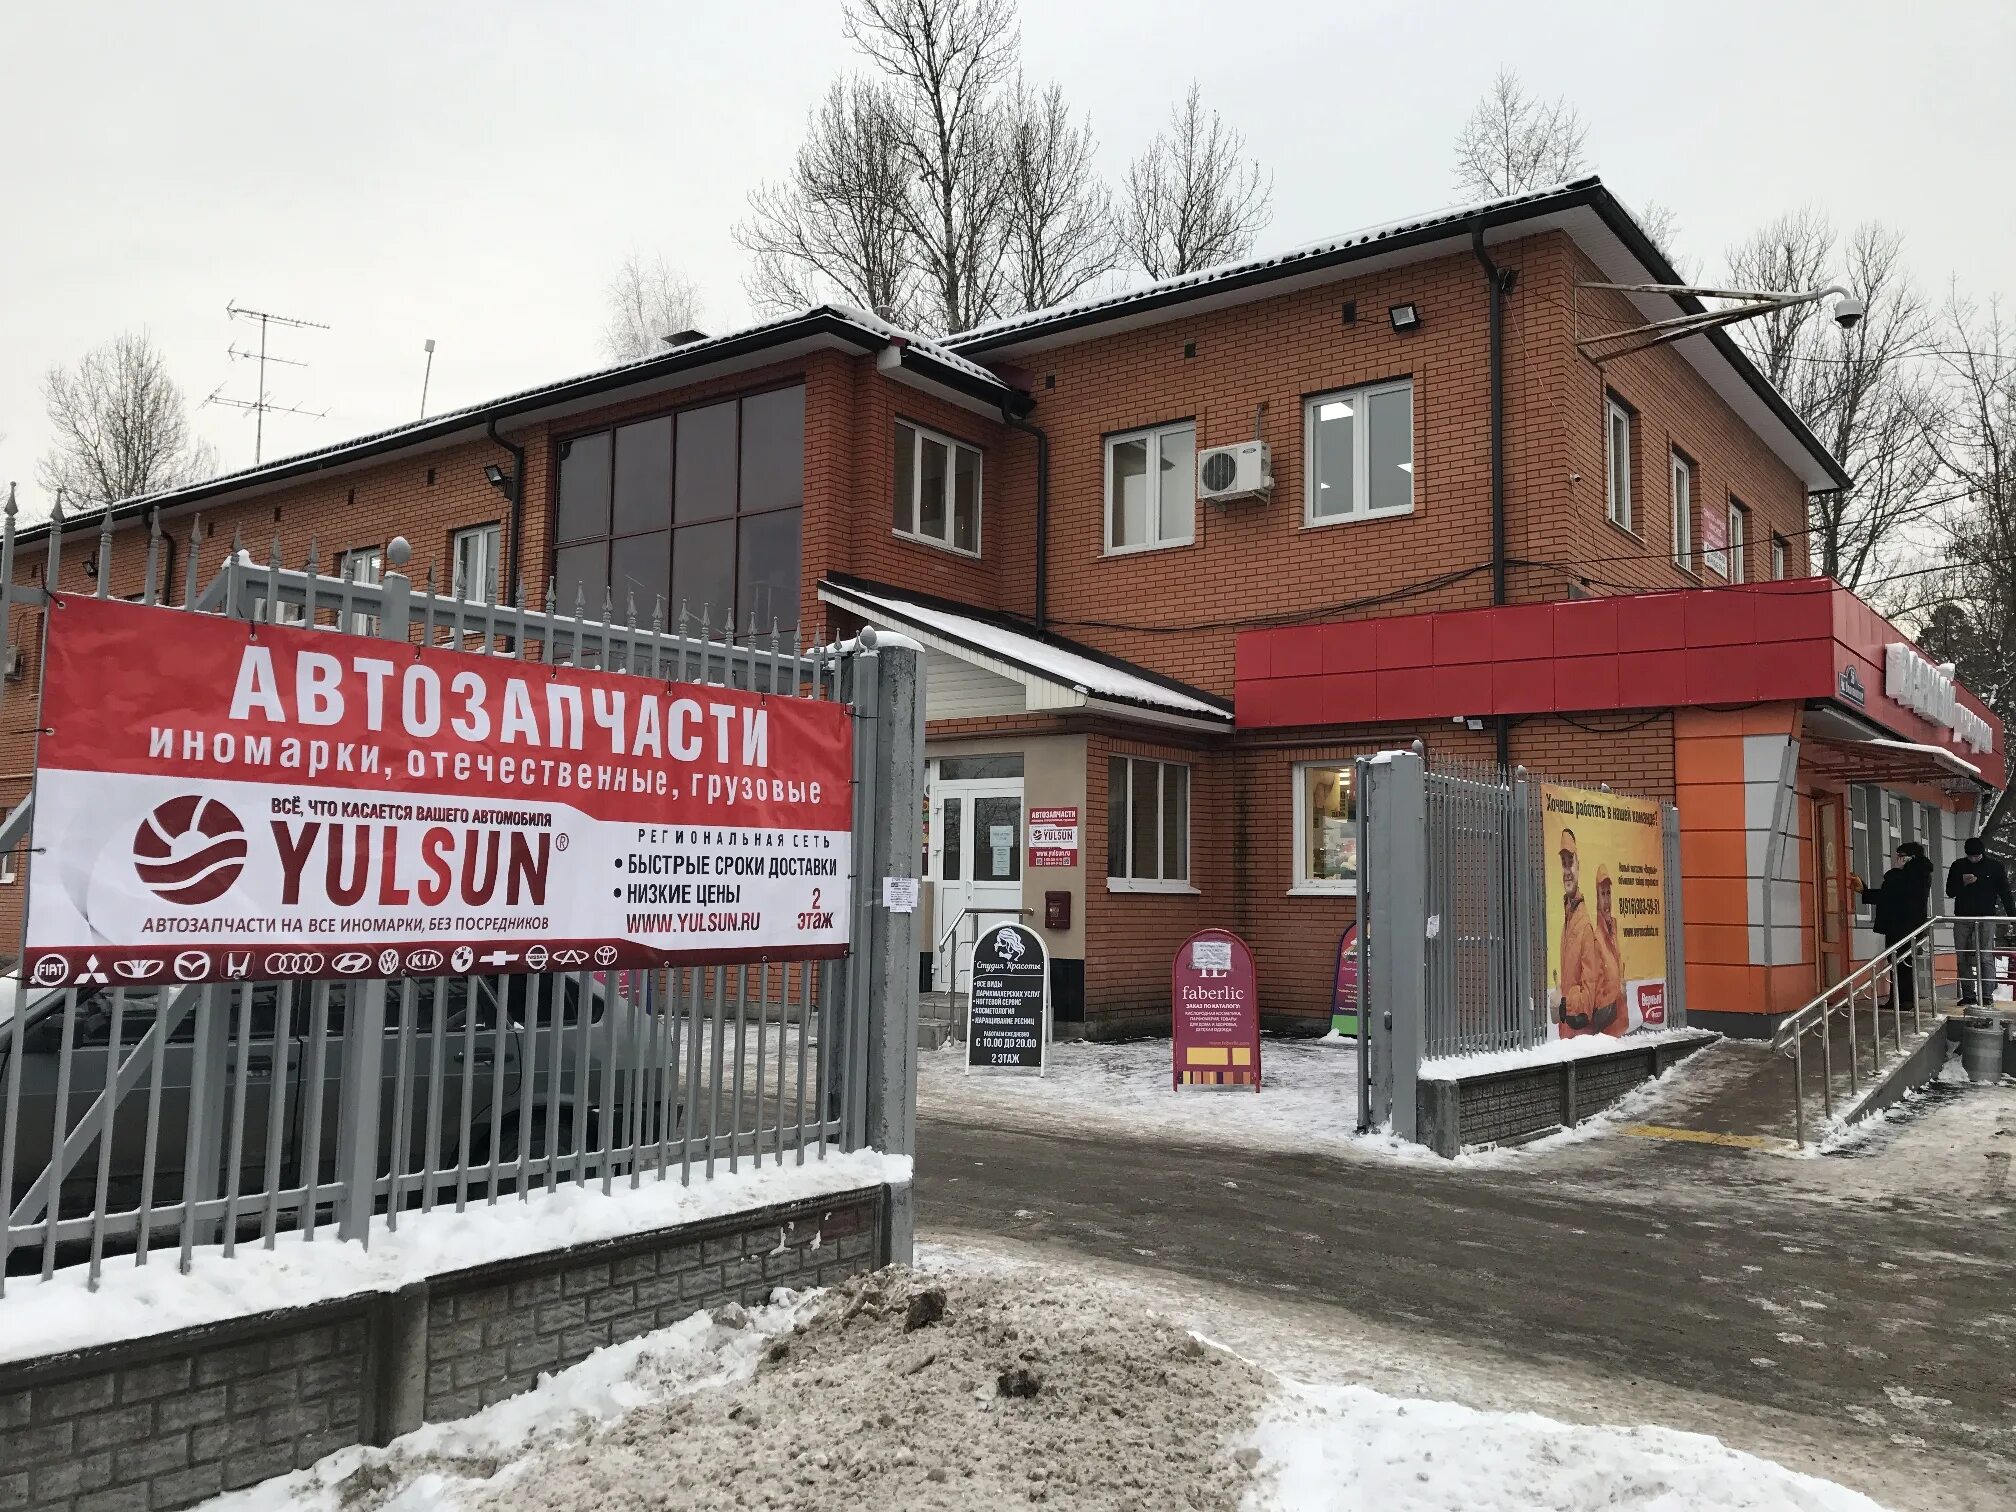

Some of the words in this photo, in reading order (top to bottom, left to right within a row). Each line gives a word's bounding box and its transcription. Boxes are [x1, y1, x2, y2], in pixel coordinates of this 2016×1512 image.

[229, 645, 768, 768] АВТОЗАПЧАСТИ
[148, 727, 392, 780] иномарки,
[407, 748, 679, 799] отечественные,
[691, 771, 822, 806] грузовые
[271, 796, 303, 817] ВСЁ,
[308, 800, 338, 816] ЧТО
[341, 802, 412, 820] КАСАЕТСЯ
[416, 806, 469, 824] ВАШЕГО
[471, 808, 552, 827] АВТОМОБИЛЯ
[1031, 810, 1076, 819] АВТОЗАПЧАСТИ
[1546, 794, 1574, 814] Хочешь
[1576, 800, 1606, 819] работать
[1607, 807, 1612, 819] в
[637, 828, 784, 847] РЕГИОНАЛЬНАЯ
[793, 834, 830, 849] СЕТЬ
[1043, 831, 1073, 840] YULSUN
[270, 820, 552, 907] YULSUN
[628, 853, 710, 875] БЫСТРЫЕ
[715, 856, 764, 876] СРОКИ
[768, 857, 838, 879] ДОСТАВКИ
[627, 883, 692, 904] НИЗКИЕ
[697, 885, 741, 907] ЦЕНЫ
[812, 887, 821, 910] 2
[141, 917, 276, 933] АВТОЗАПЧАСТИ
[281, 918, 304, 933] НА
[308, 918, 336, 933] ВСЕ
[340, 917, 426, 934] ИНОМАРКИ,
[429, 917, 451, 931] БЕЗ
[455, 916, 549, 932] ПОСРЕДНИКОВ
[626, 911, 761, 934] WWW.YULSUN.RU
[797, 911, 834, 930] этаж
[411, 954, 437, 966] KIA
[976, 961, 1004, 972] Студия
[1006, 961, 1041, 972] Красоты
[38, 963, 64, 976] FIAT
[975, 998, 1002, 1006] НОГТЕВОЙ
[1182, 986, 1245, 1000] faberlic
[975, 1017, 1013, 1025] НАРАЩИВАНИЕ
[1014, 1018, 1035, 1026] РЕСНИЦ
[975, 1038, 980, 1047] С
[983, 1038, 1003, 1048] 10.00
[1003, 1039, 1015, 1048] ДО
[1015, 1039, 1037, 1048] 20.00
[991, 1053, 997, 1063] 2
[997, 1053, 1020, 1064] ЭТАЖ
